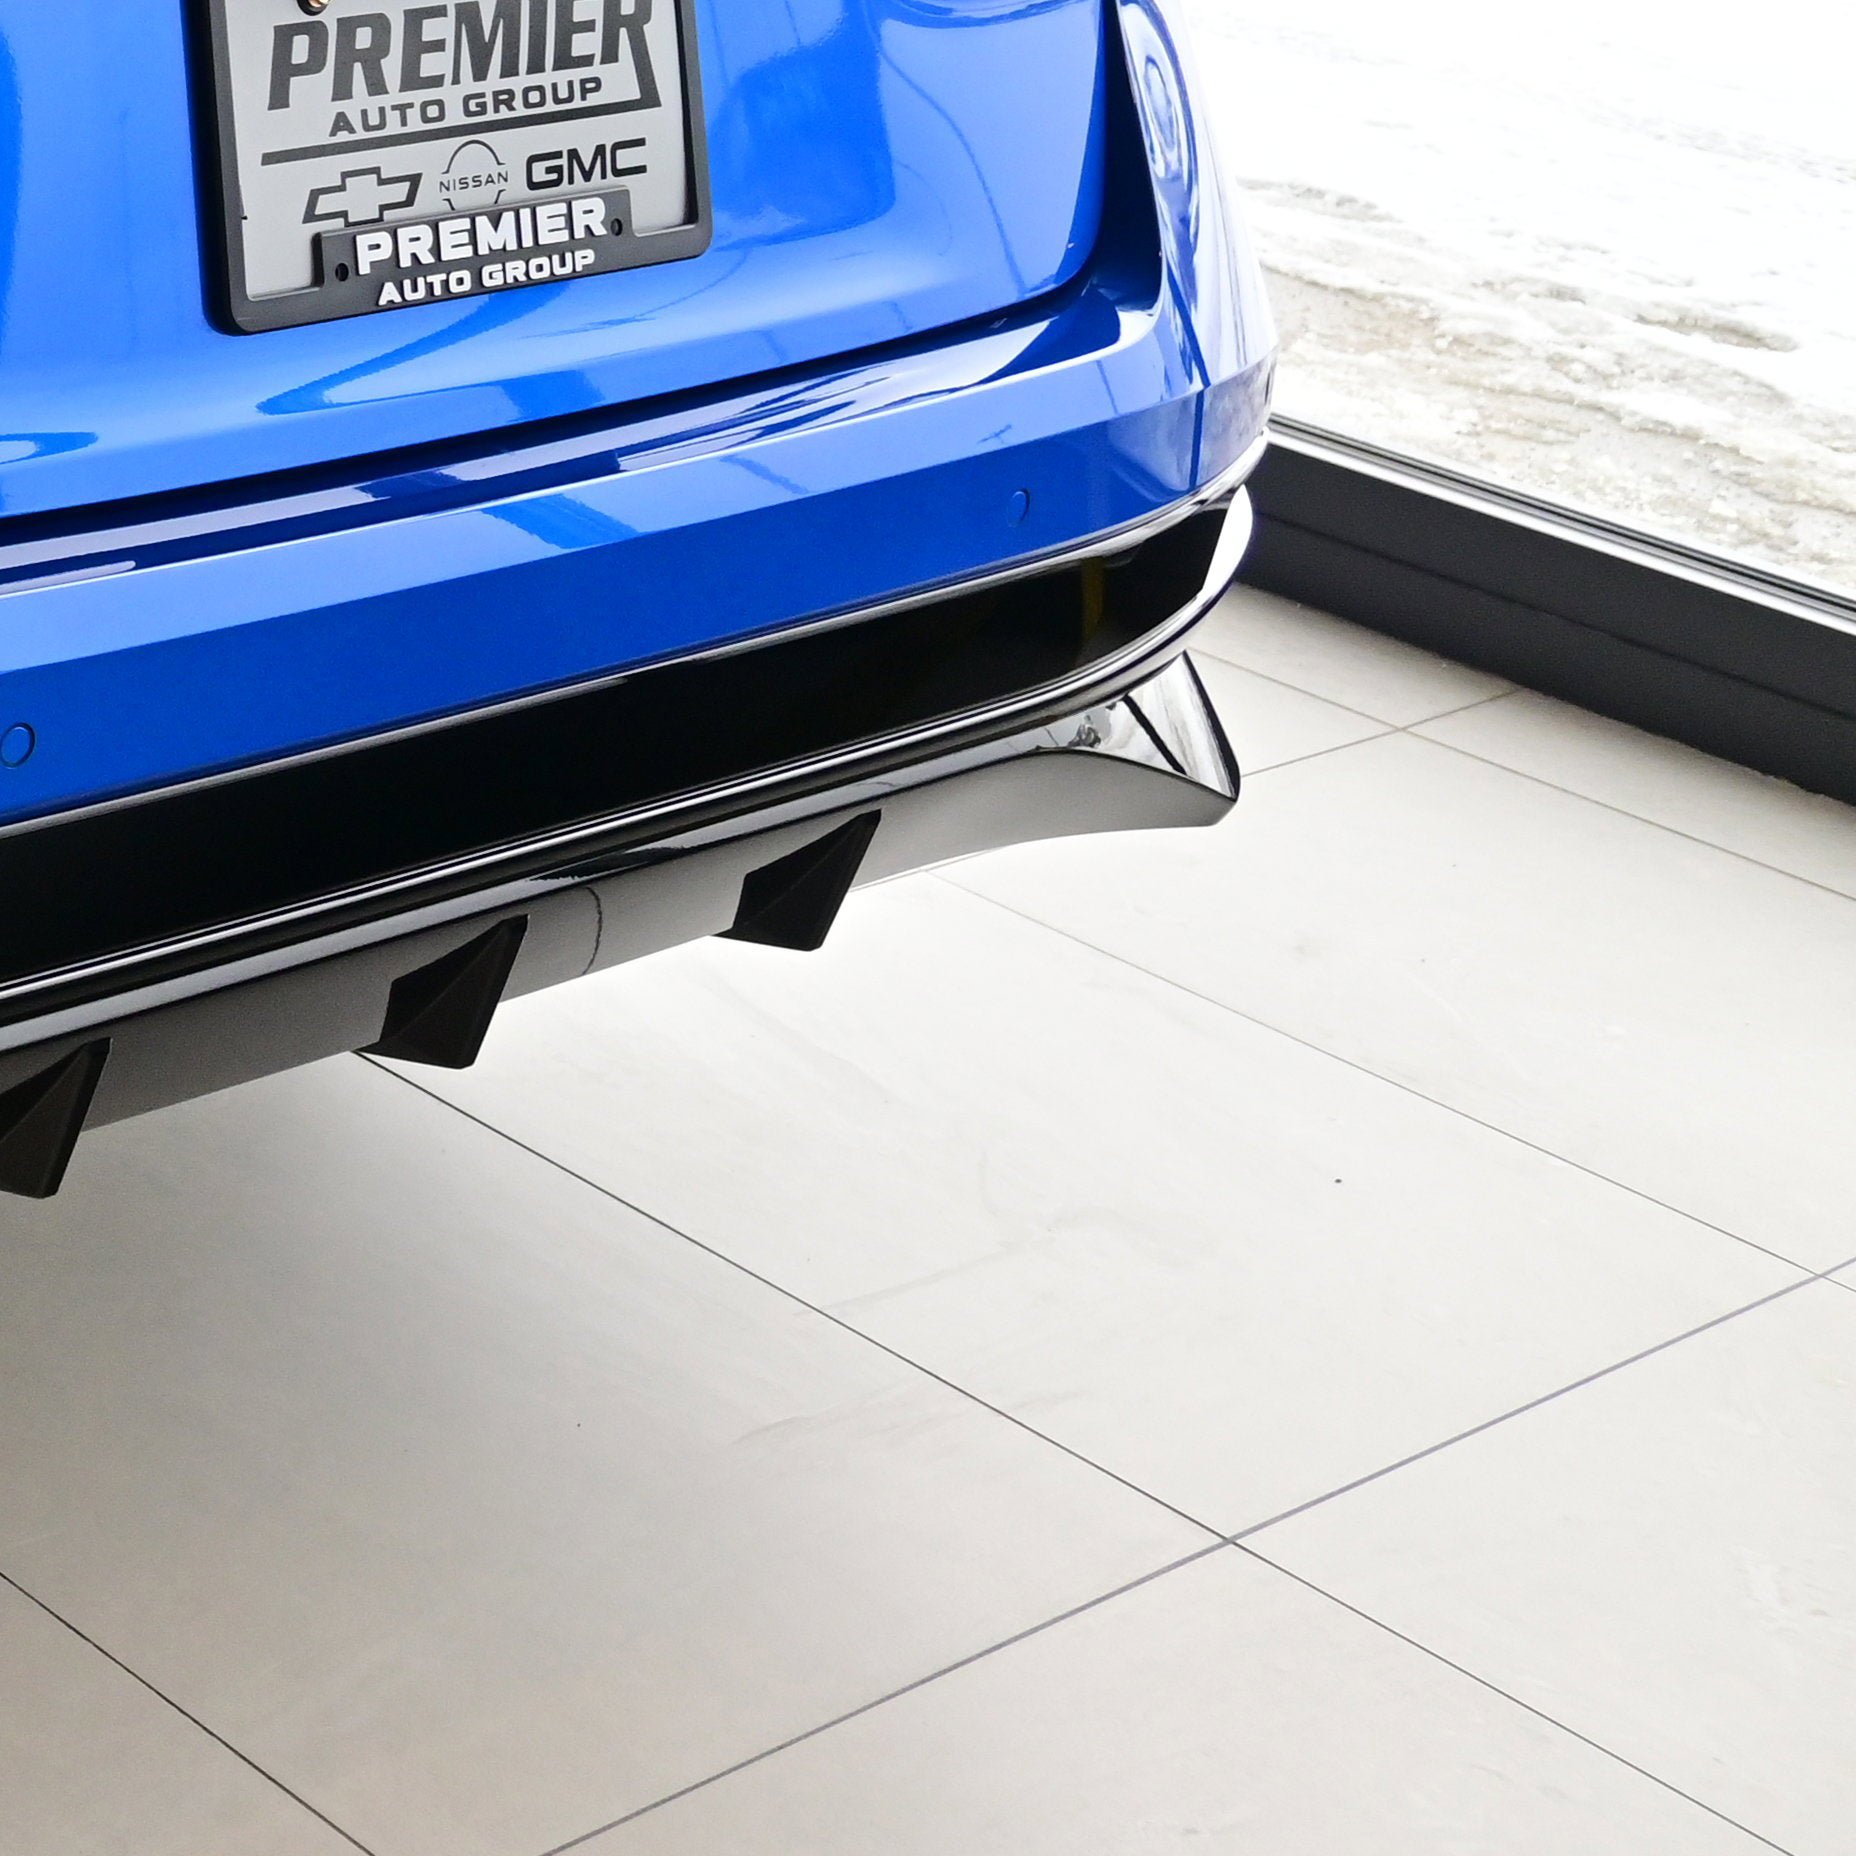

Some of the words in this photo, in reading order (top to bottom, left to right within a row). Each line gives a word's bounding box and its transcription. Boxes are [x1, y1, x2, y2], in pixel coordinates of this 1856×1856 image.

[328, 97, 447, 138] AUTO
[461, 75, 604, 119] GROUP
[439, 168, 509, 194] NISSAN
[524, 137, 648, 192] GMC
[355, 195, 608, 278] PREMIER
[376, 268, 472, 307] AUTO
[481, 248, 596, 289] GROUP
